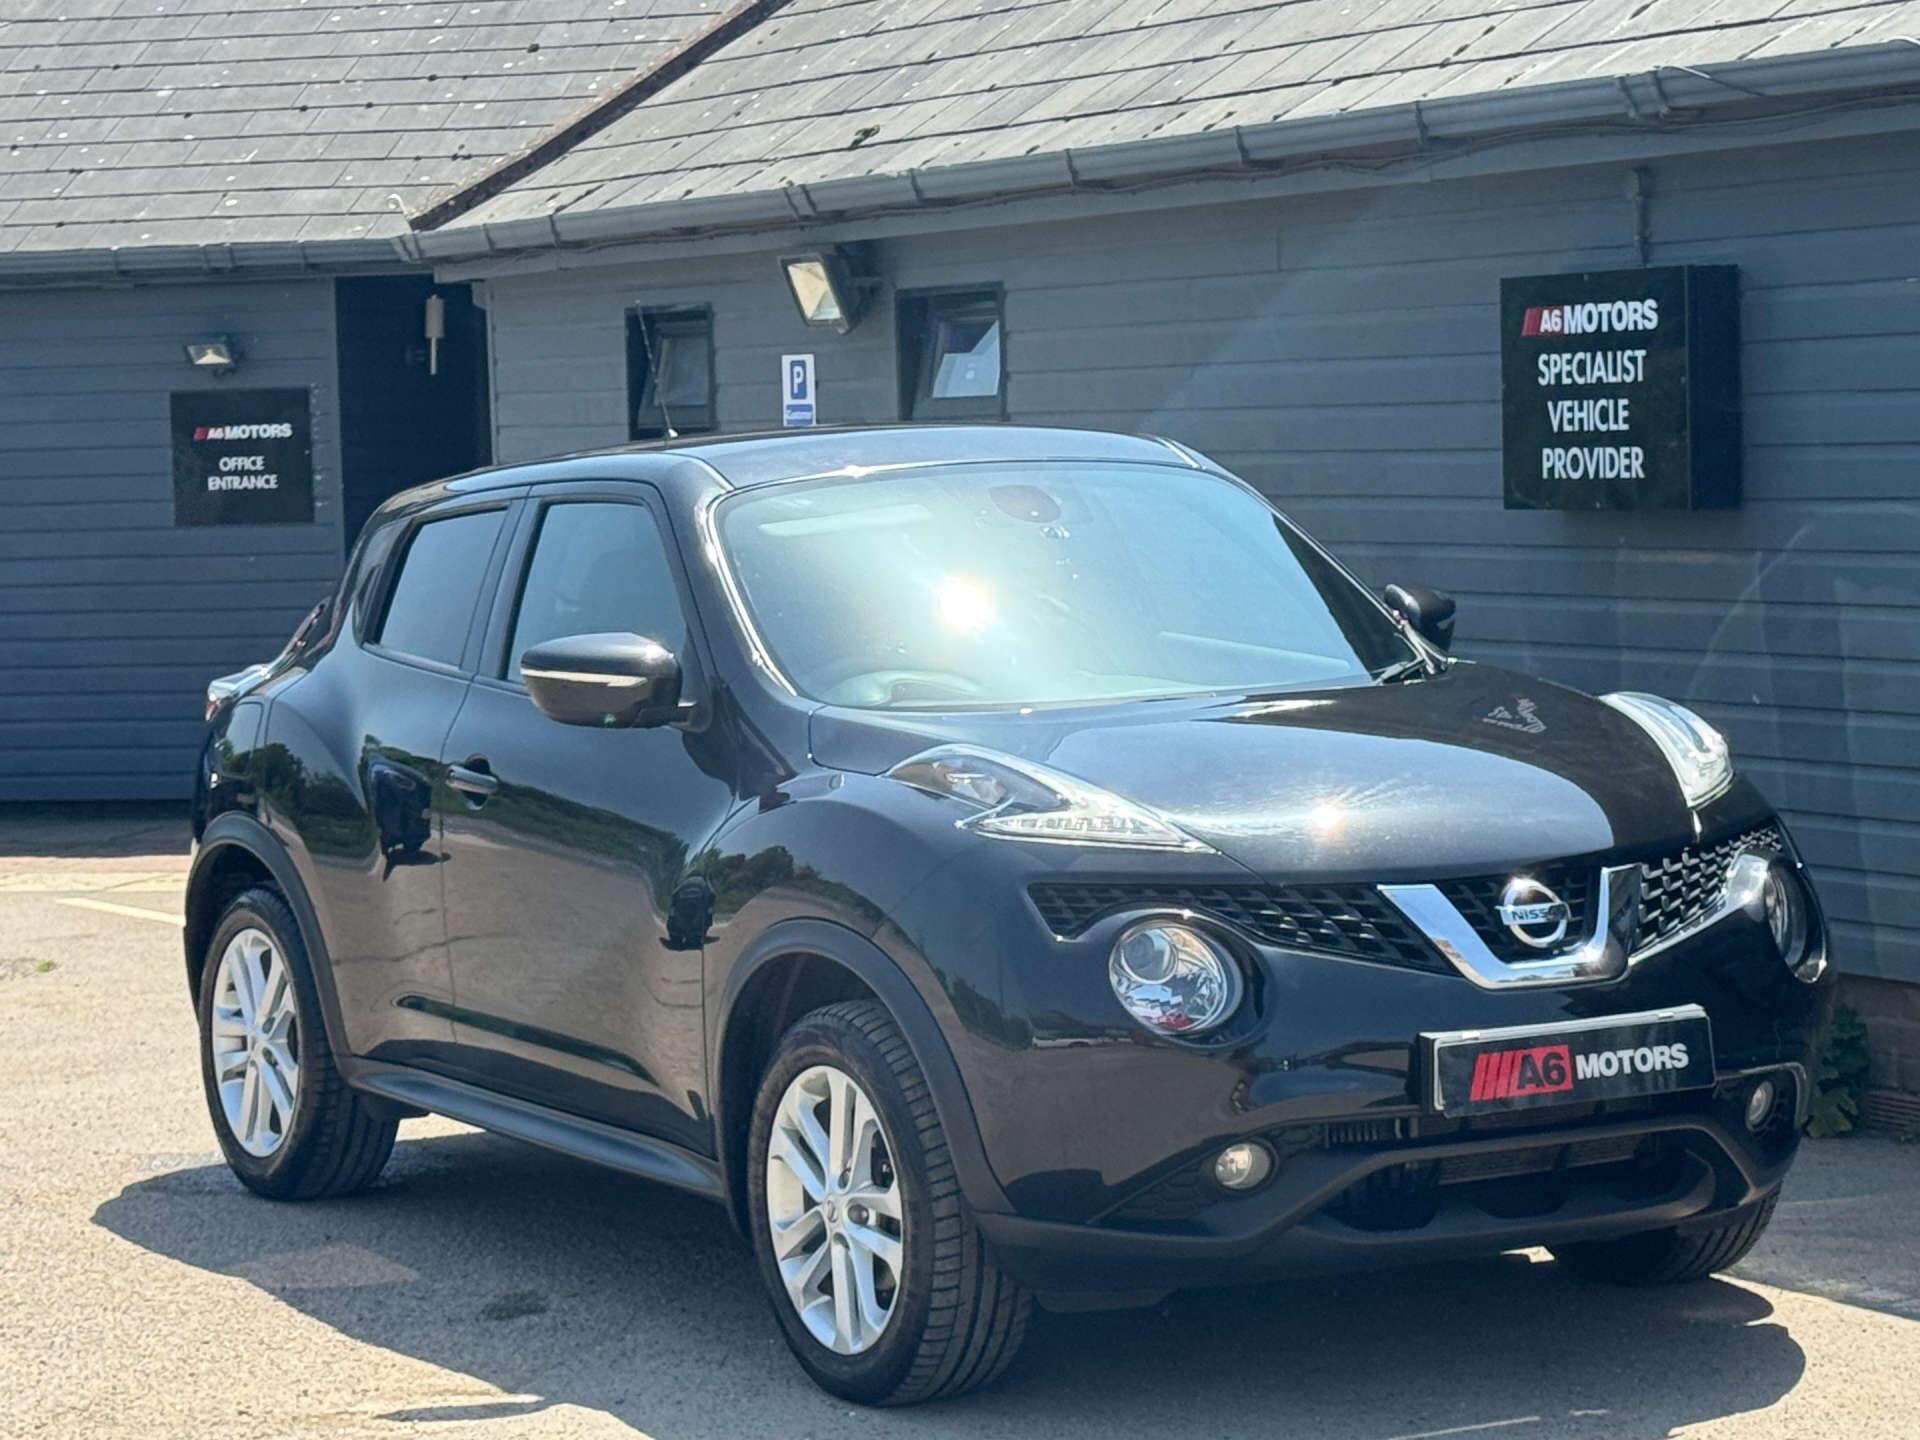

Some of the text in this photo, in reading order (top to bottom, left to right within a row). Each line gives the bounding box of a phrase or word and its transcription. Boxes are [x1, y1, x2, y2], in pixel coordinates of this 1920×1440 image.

[1540, 299, 1659, 334] A6 MOTORS
[793, 365, 804, 394] P
[1538, 350, 1646, 386] SPECIALIST
[1547, 398, 1630, 433] VEHICLE
[224, 423, 293, 439] MOTORS
[219, 456, 265, 472] OFFICE
[1542, 447, 1645, 479] PROVIDER
[207, 475, 279, 490] ENTRANCE
[1512, 906, 1562, 920] NISS
[1517, 1043, 1690, 1090] A6 MOTORS
